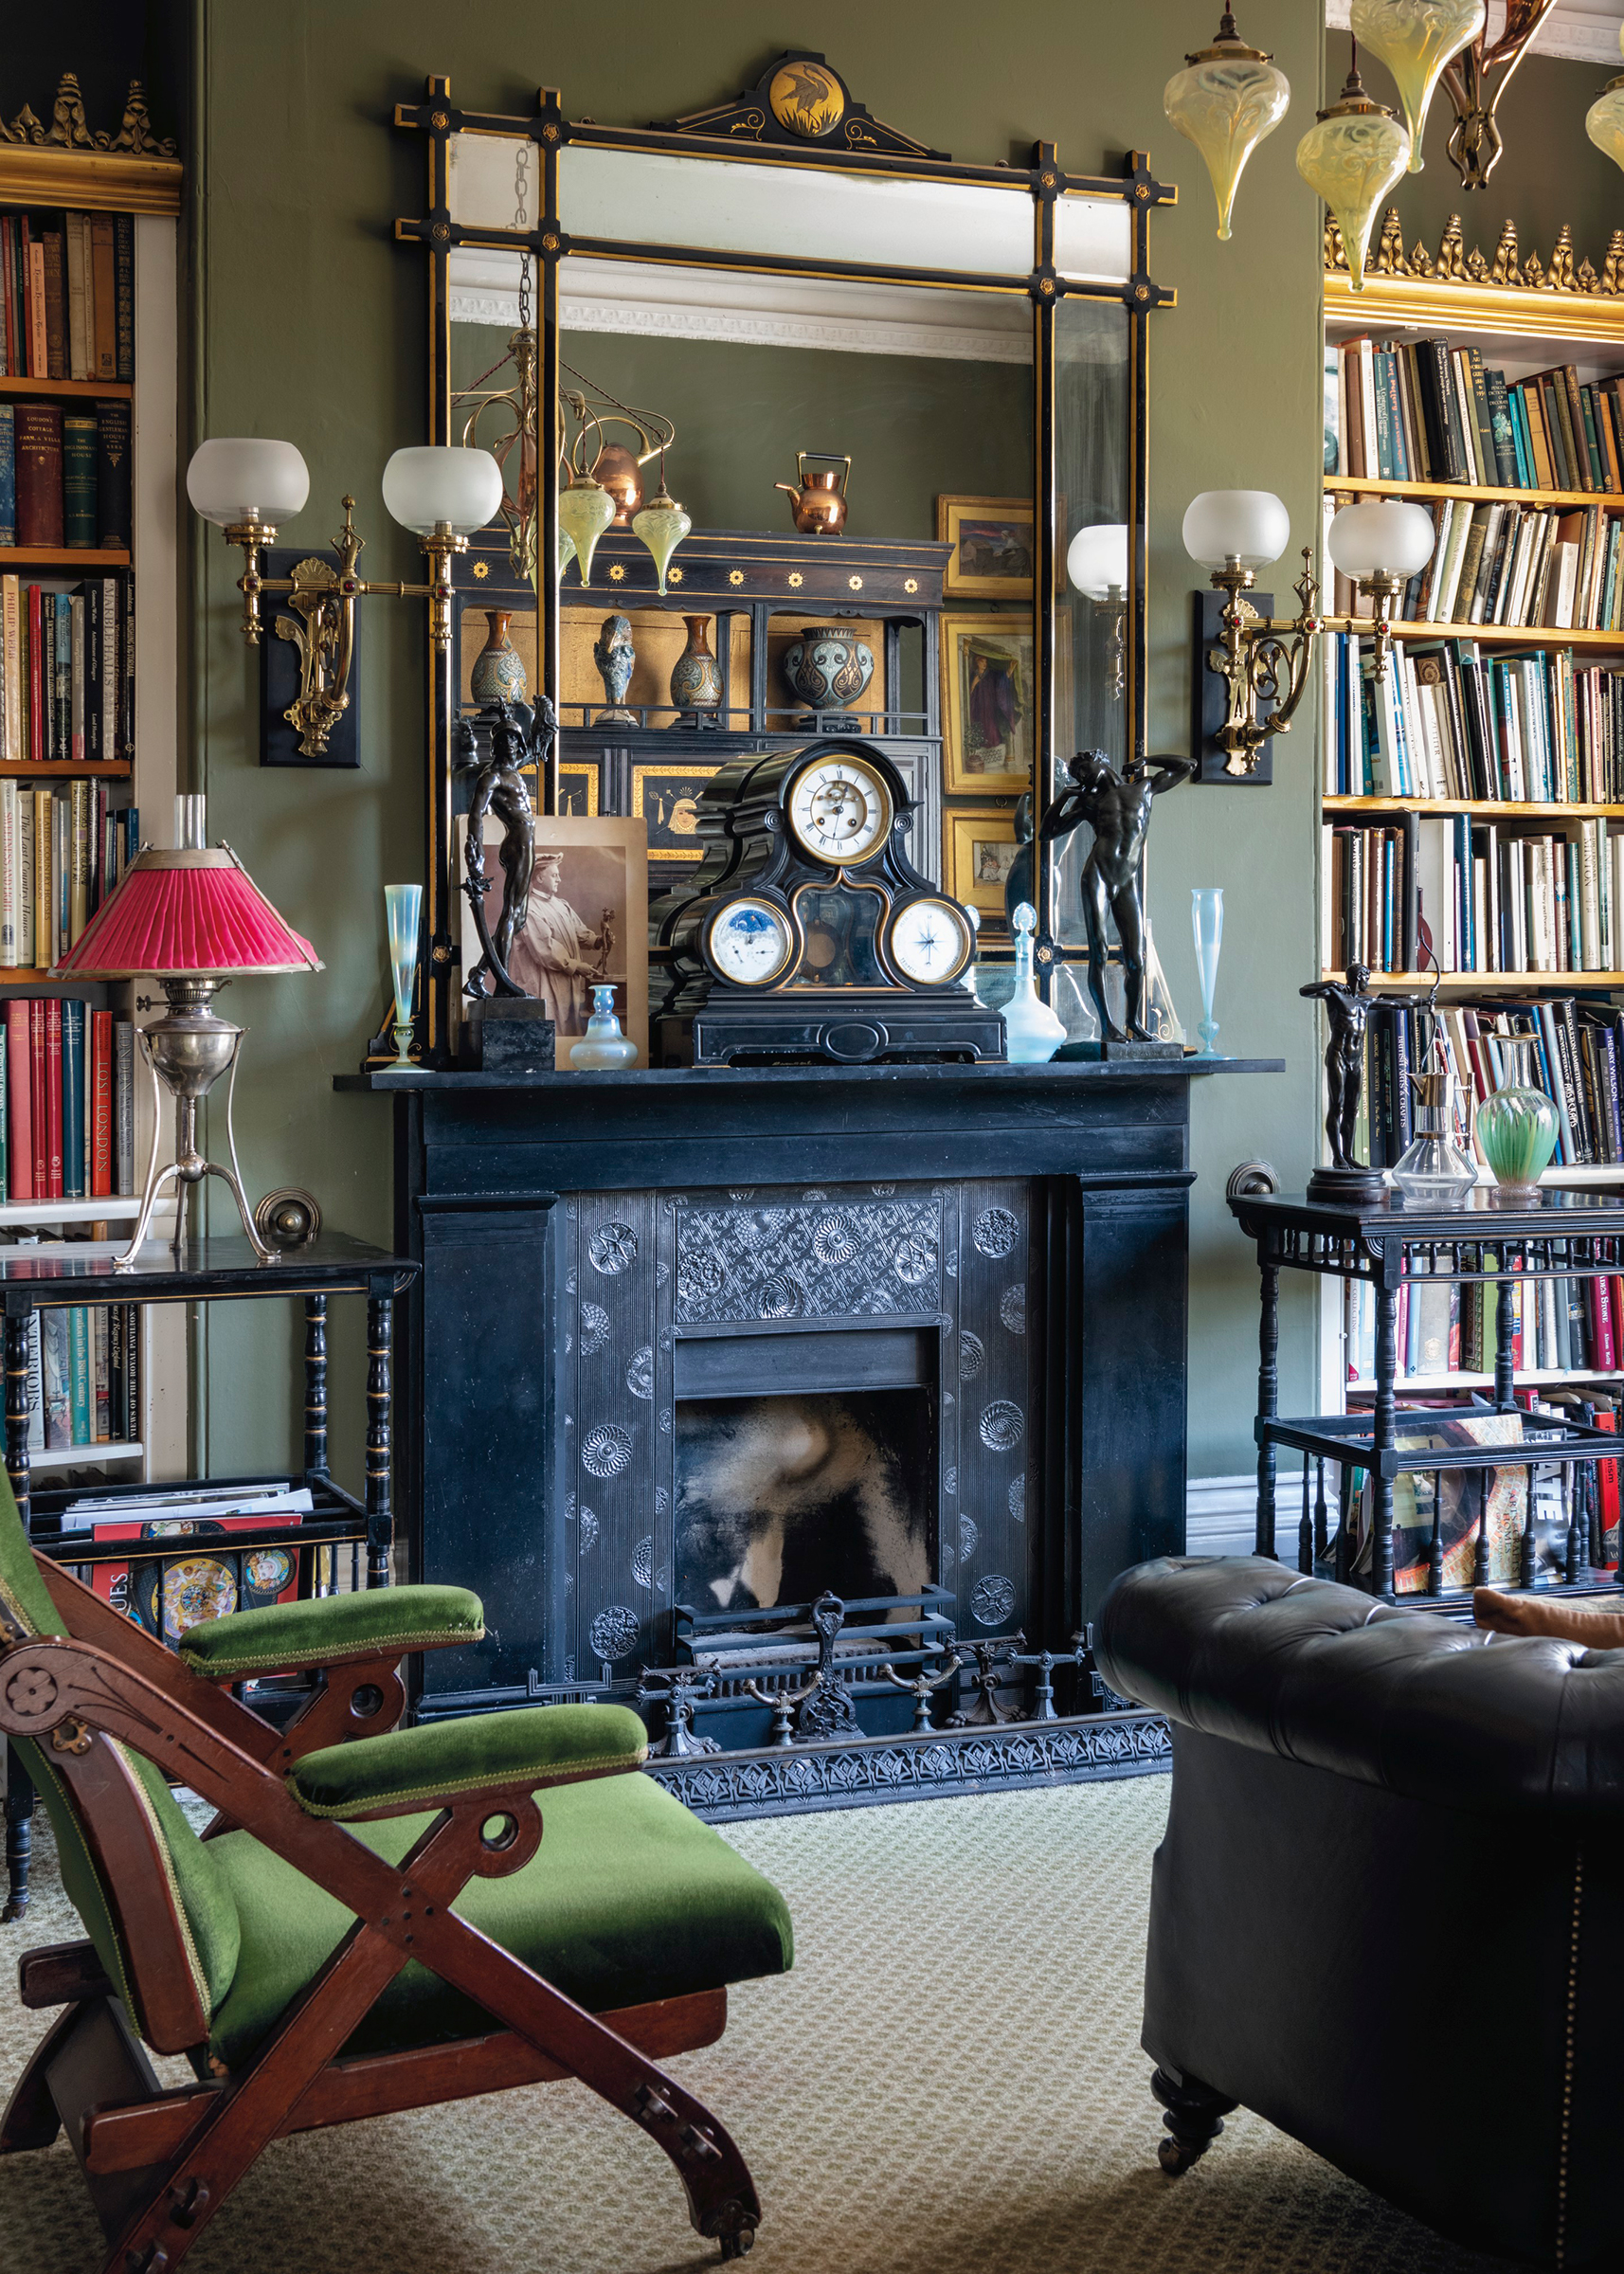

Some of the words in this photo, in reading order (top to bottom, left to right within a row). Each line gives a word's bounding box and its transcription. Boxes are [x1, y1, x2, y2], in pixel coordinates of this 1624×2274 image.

[1389, 379, 1398, 411] Pottery
[1455, 358, 1464, 400] MASTERPIECES
[1461, 409, 1471, 446] WEDGWOOD
[1455, 504, 1469, 534] Staffordshire
[7, 591, 15, 628] PHILIP
[104, 584, 115, 641] 'MARBLE
[8, 629, 16, 659] WEBB
[3, 812, 12, 865] SWEETNESS
[22, 814, 30, 833] The
[21, 836, 30, 857] Last
[1352, 836, 1362, 868] Jewitt's
[3, 866, 12, 886] AND
[1583, 838, 1592, 887] MINTON
[19, 860, 31, 901] Country
[3, 887, 13, 914] LIGHT
[22, 904, 31, 938] Houses
[1558, 1028, 1568, 1073] ENCYCLOPEDIA
[1568, 1019, 1578, 1051] DOULTON
[1607, 1036, 1615, 1065] HENRY
[118, 1025, 133, 1093] LONDON
[1572, 1051, 1581, 1081] LAMBETH
[97, 1062, 108, 1099] LOST
[1563, 1083, 1575, 1098] ARTS
[1568, 1103, 1577, 1128] CRAFTS
[97, 1105, 108, 1172] LONDON
[1600, 1296, 1609, 1324] STONE
[111, 1324, 120, 1345] Regency
[77, 1346, 85, 1359] the
[77, 1360, 85, 1376] 18th
[74, 1376, 86, 1407] Century
[1508, 1491, 1518, 1522] ARTS
[1503, 1513, 1511, 1554] HOMES
[110, 1573, 132, 1615] UES
